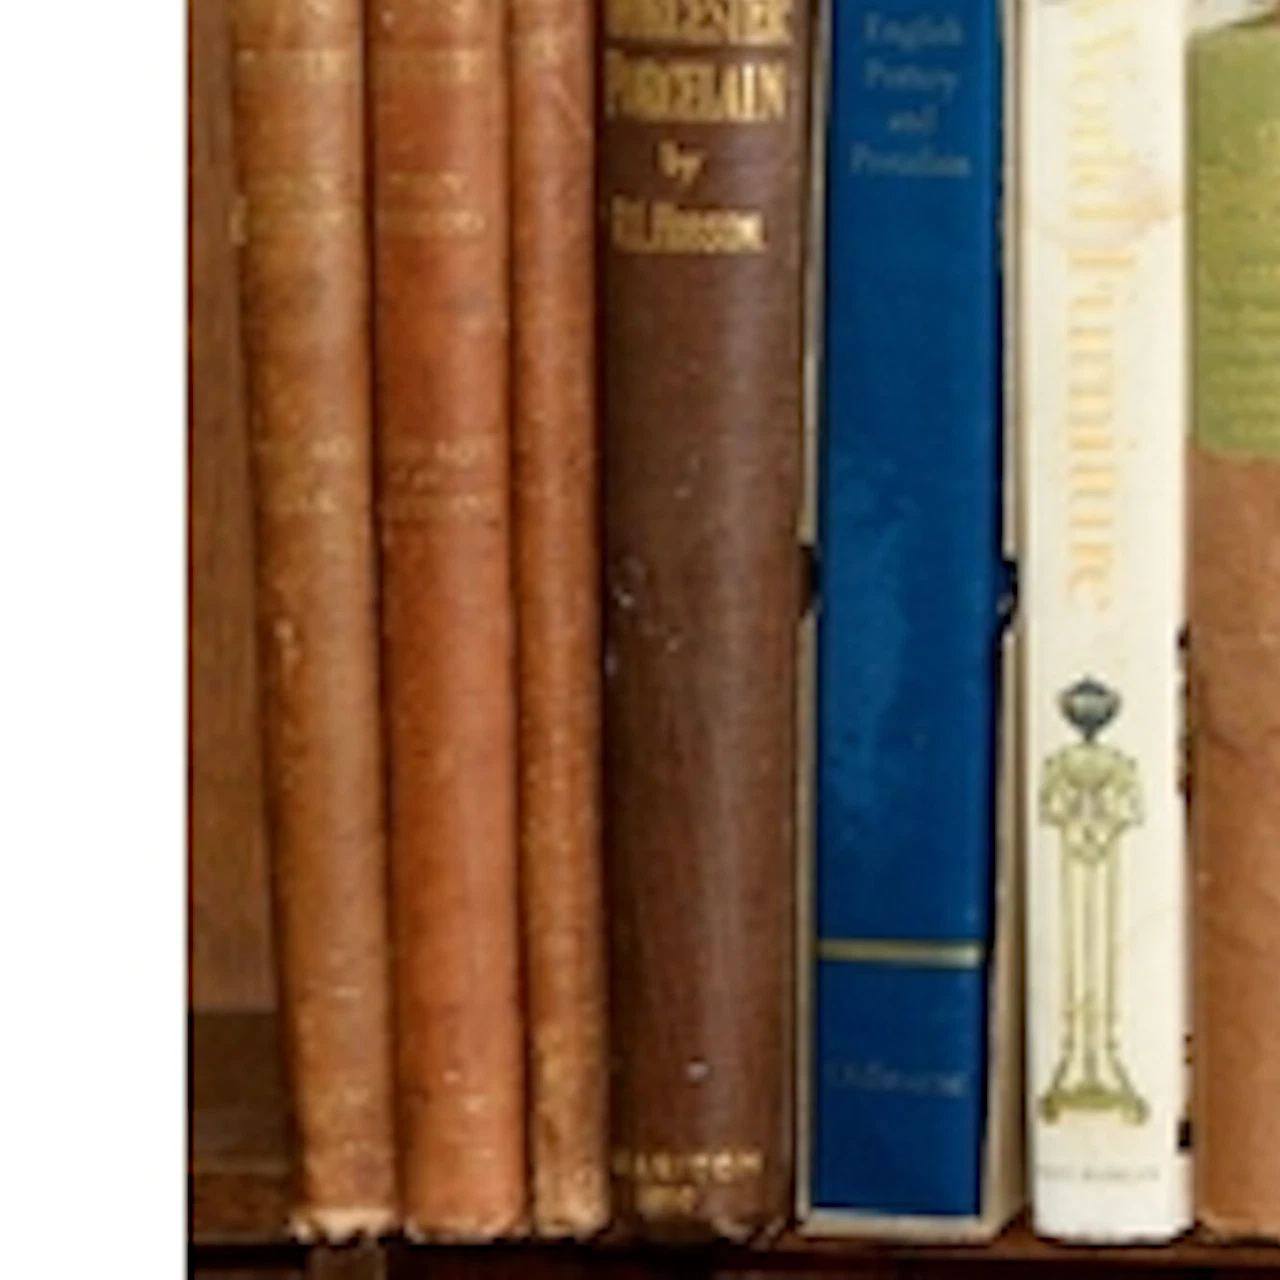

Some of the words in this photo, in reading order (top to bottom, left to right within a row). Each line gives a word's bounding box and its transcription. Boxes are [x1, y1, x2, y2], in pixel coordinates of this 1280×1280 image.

[863, 12, 962, 51] English
[606, 57, 788, 123] PORCELAIN
[863, 62, 957, 99] Pottery
[887, 107, 937, 134] and
[657, 141, 706, 187] by
[849, 144, 973, 180] Porcelain
[1066, 243, 1137, 612] Furniture
